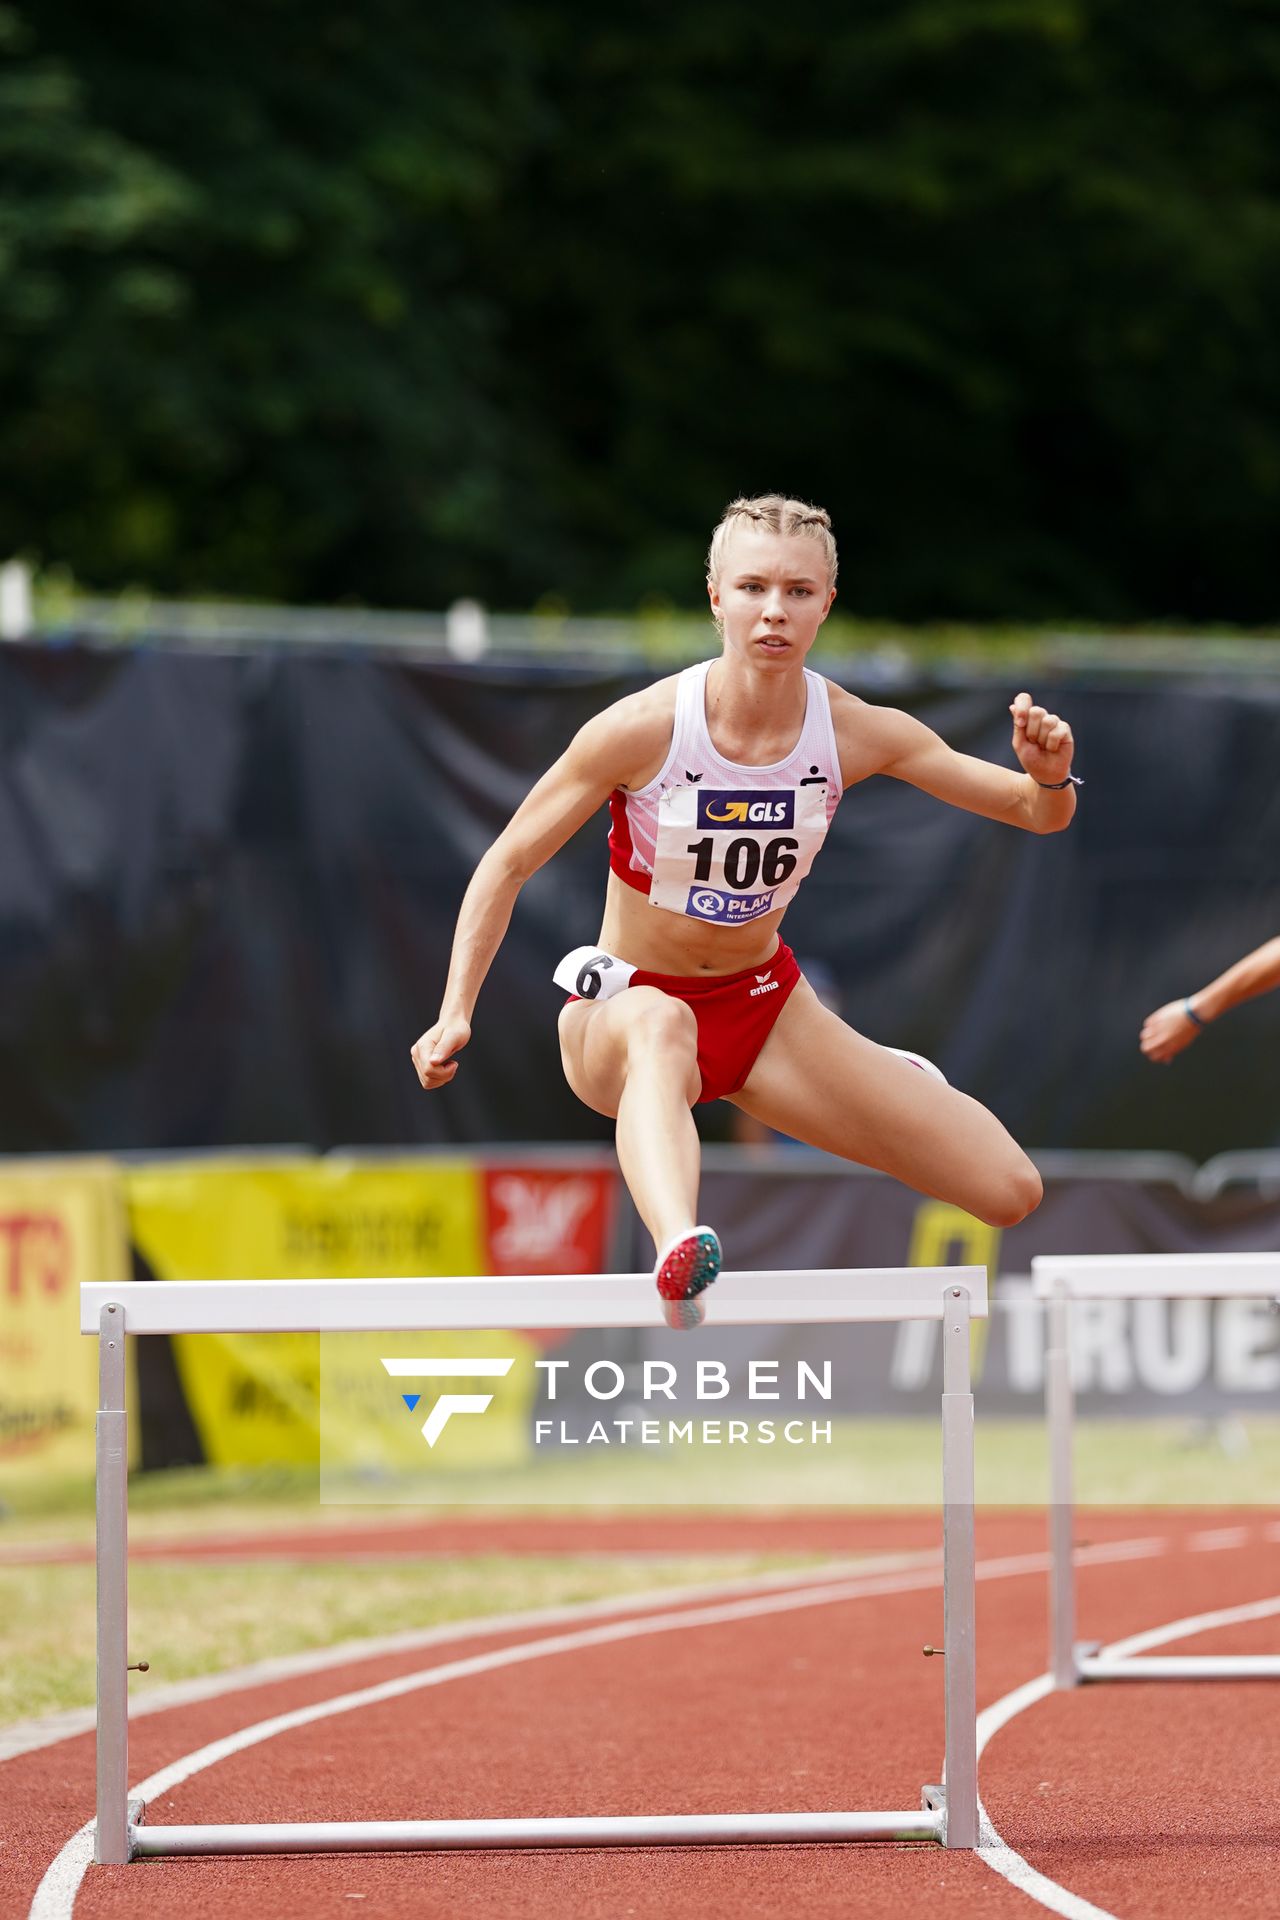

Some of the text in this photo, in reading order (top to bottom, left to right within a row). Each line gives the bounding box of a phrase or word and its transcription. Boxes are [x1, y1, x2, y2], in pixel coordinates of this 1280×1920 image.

[748, 801, 787, 823] GLS
[687, 837, 800, 890] 106
[727, 892, 774, 912] PLAN
[575, 954, 613, 1000] 6
[749, 980, 780, 997] erima
